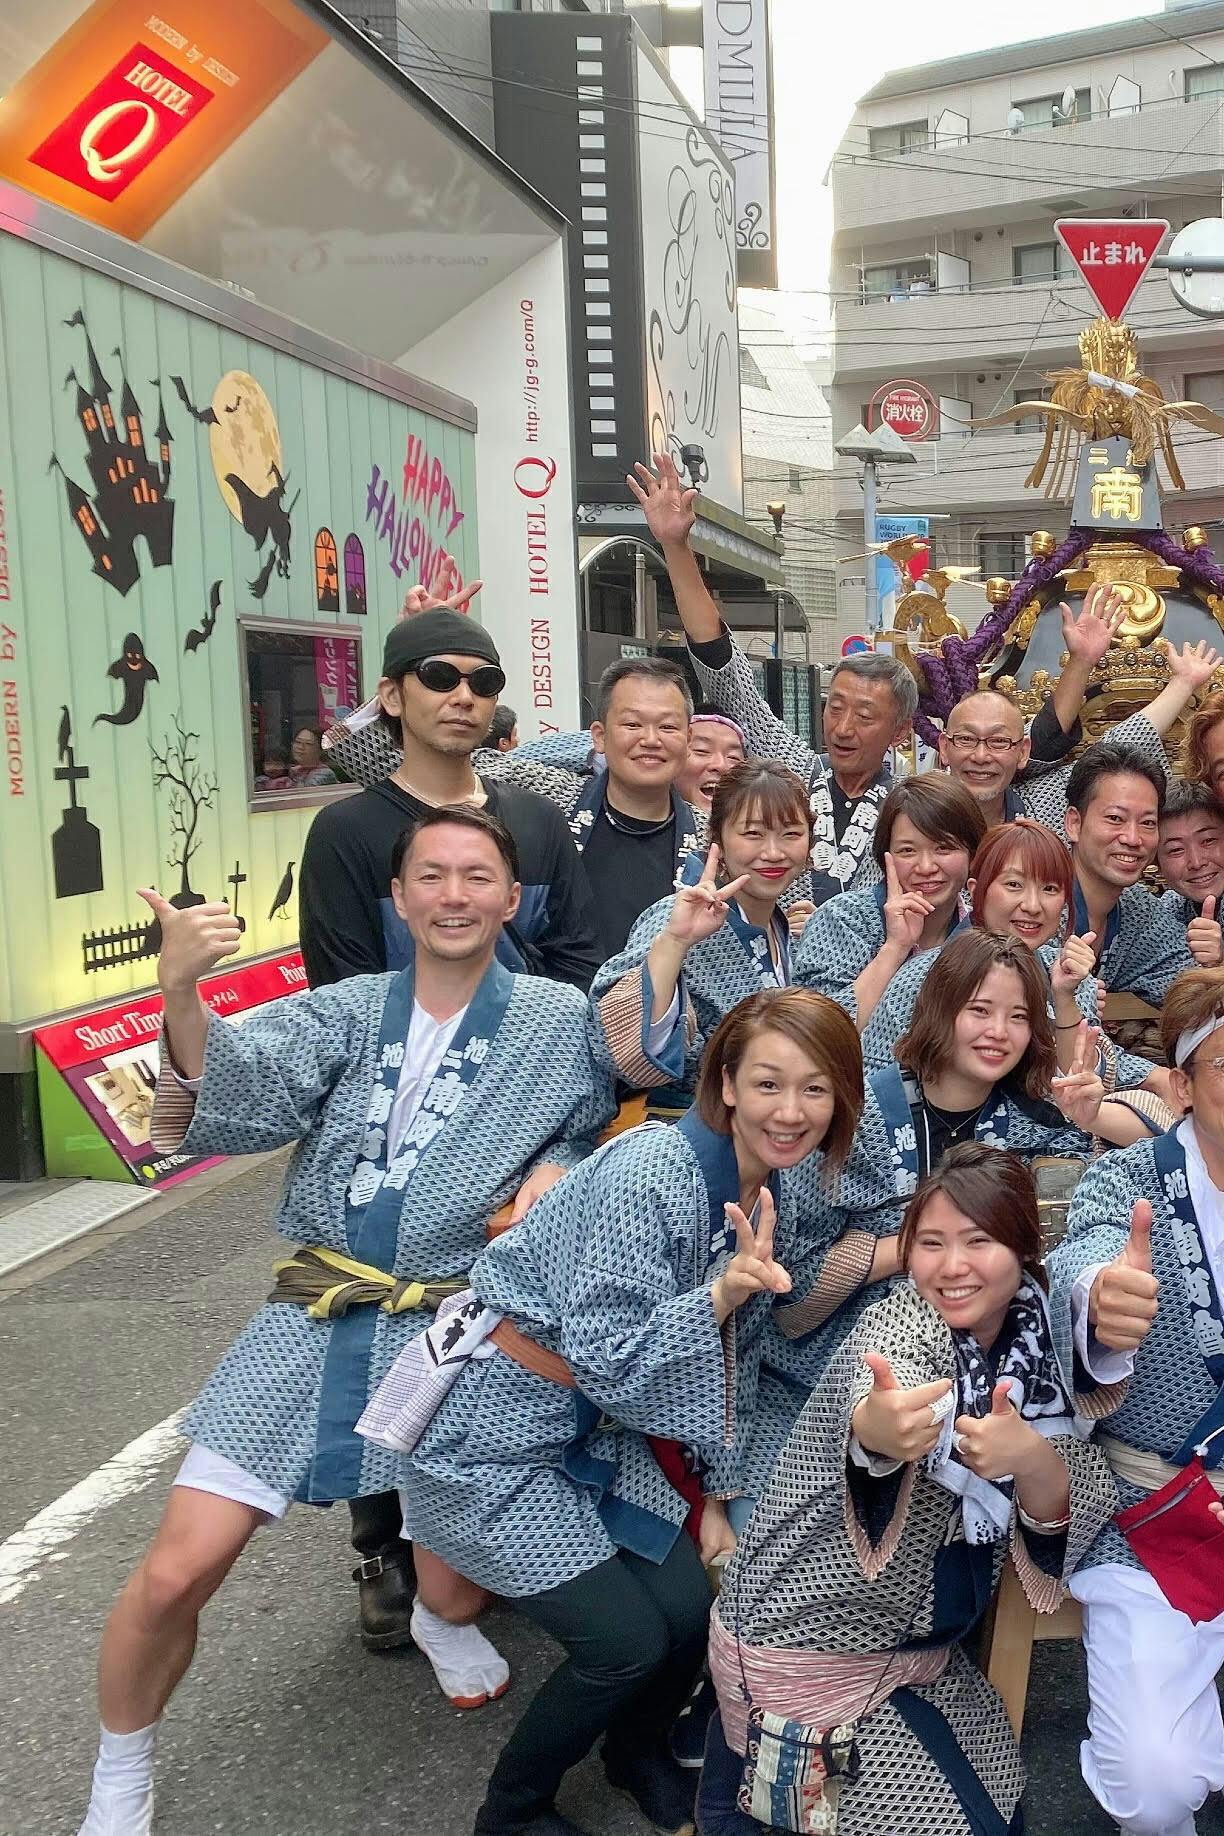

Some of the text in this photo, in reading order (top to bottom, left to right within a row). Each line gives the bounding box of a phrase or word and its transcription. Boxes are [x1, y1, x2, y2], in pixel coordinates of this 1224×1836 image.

[123, 60, 193, 118] HOTEL
[79, 99, 156, 183] Q
[1079, 241, 1147, 265] 止まれ
[520, 298, 539, 443] http://jg-g.com/Q
[885, 402, 924, 423] 消火栓
[403, 432, 465, 539] HAPPY
[513, 456, 557, 499] Q
[1090, 467, 1144, 522] 南
[526, 503, 551, 596] HOTEL
[879, 524, 906, 532] RUGBY
[530, 618, 553, 709] DESIGN
[3, 680, 25, 797] MODERN
[277, 963, 308, 986] Poin
[74, 1020, 132, 1051] Short
